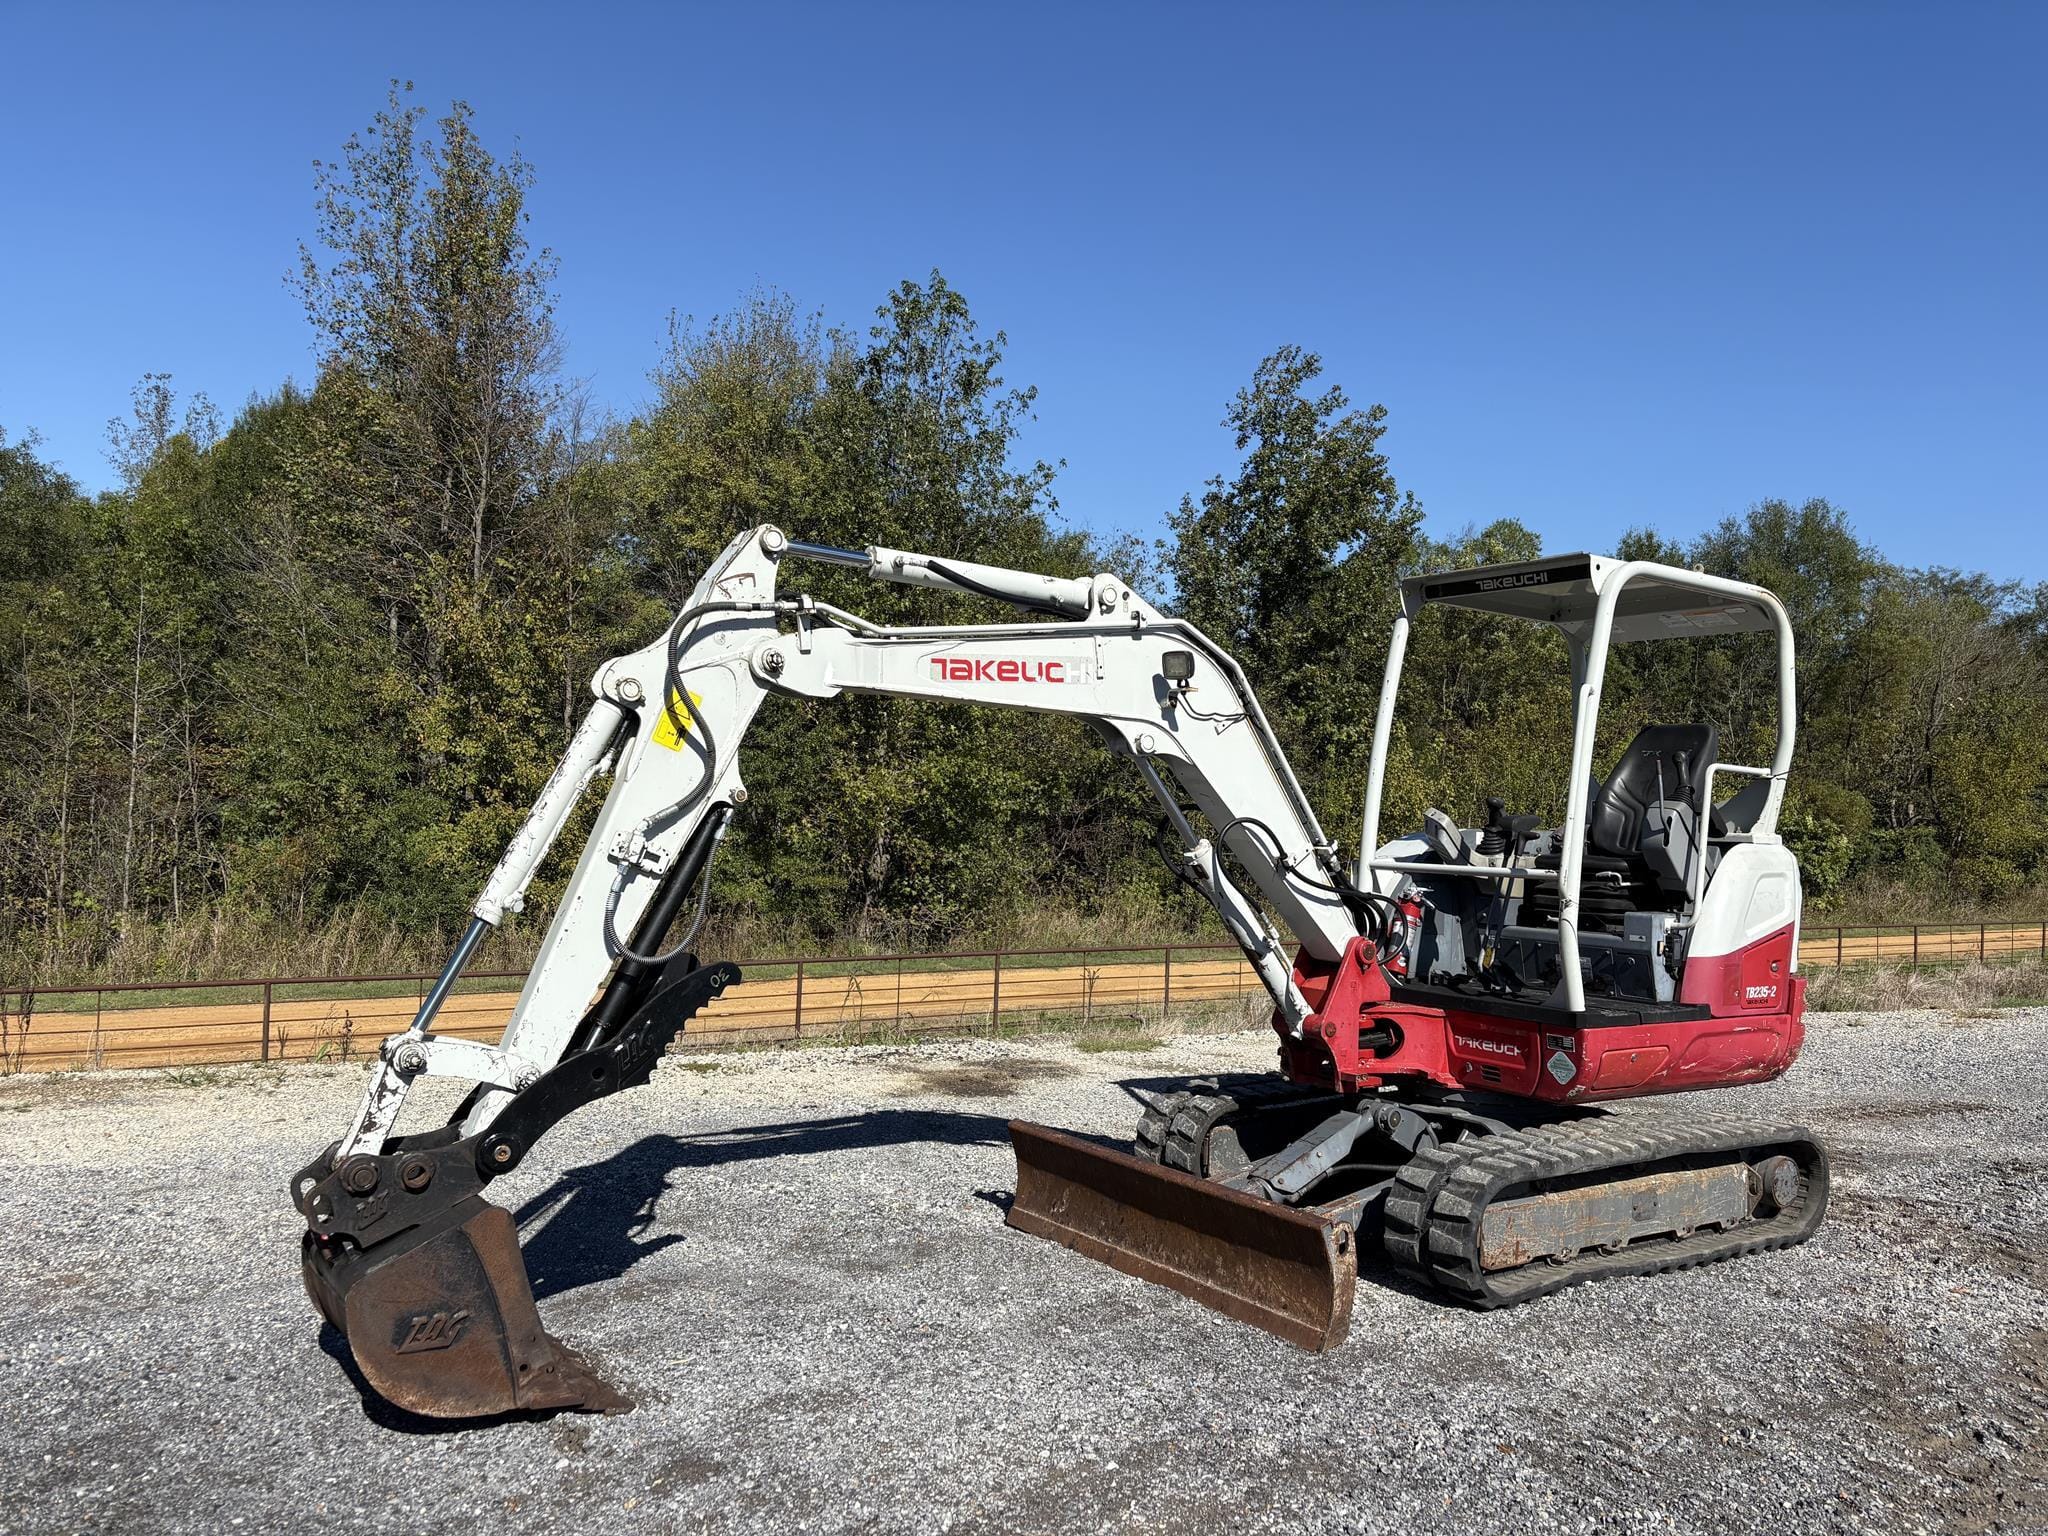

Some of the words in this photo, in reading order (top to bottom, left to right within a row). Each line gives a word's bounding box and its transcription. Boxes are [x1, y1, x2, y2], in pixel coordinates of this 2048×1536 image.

[1475, 572, 1548, 591] TAKEUCHI
[1745, 985, 1777, 998] TB235-2
[1455, 1035, 1522, 1056] TAKEUCH
